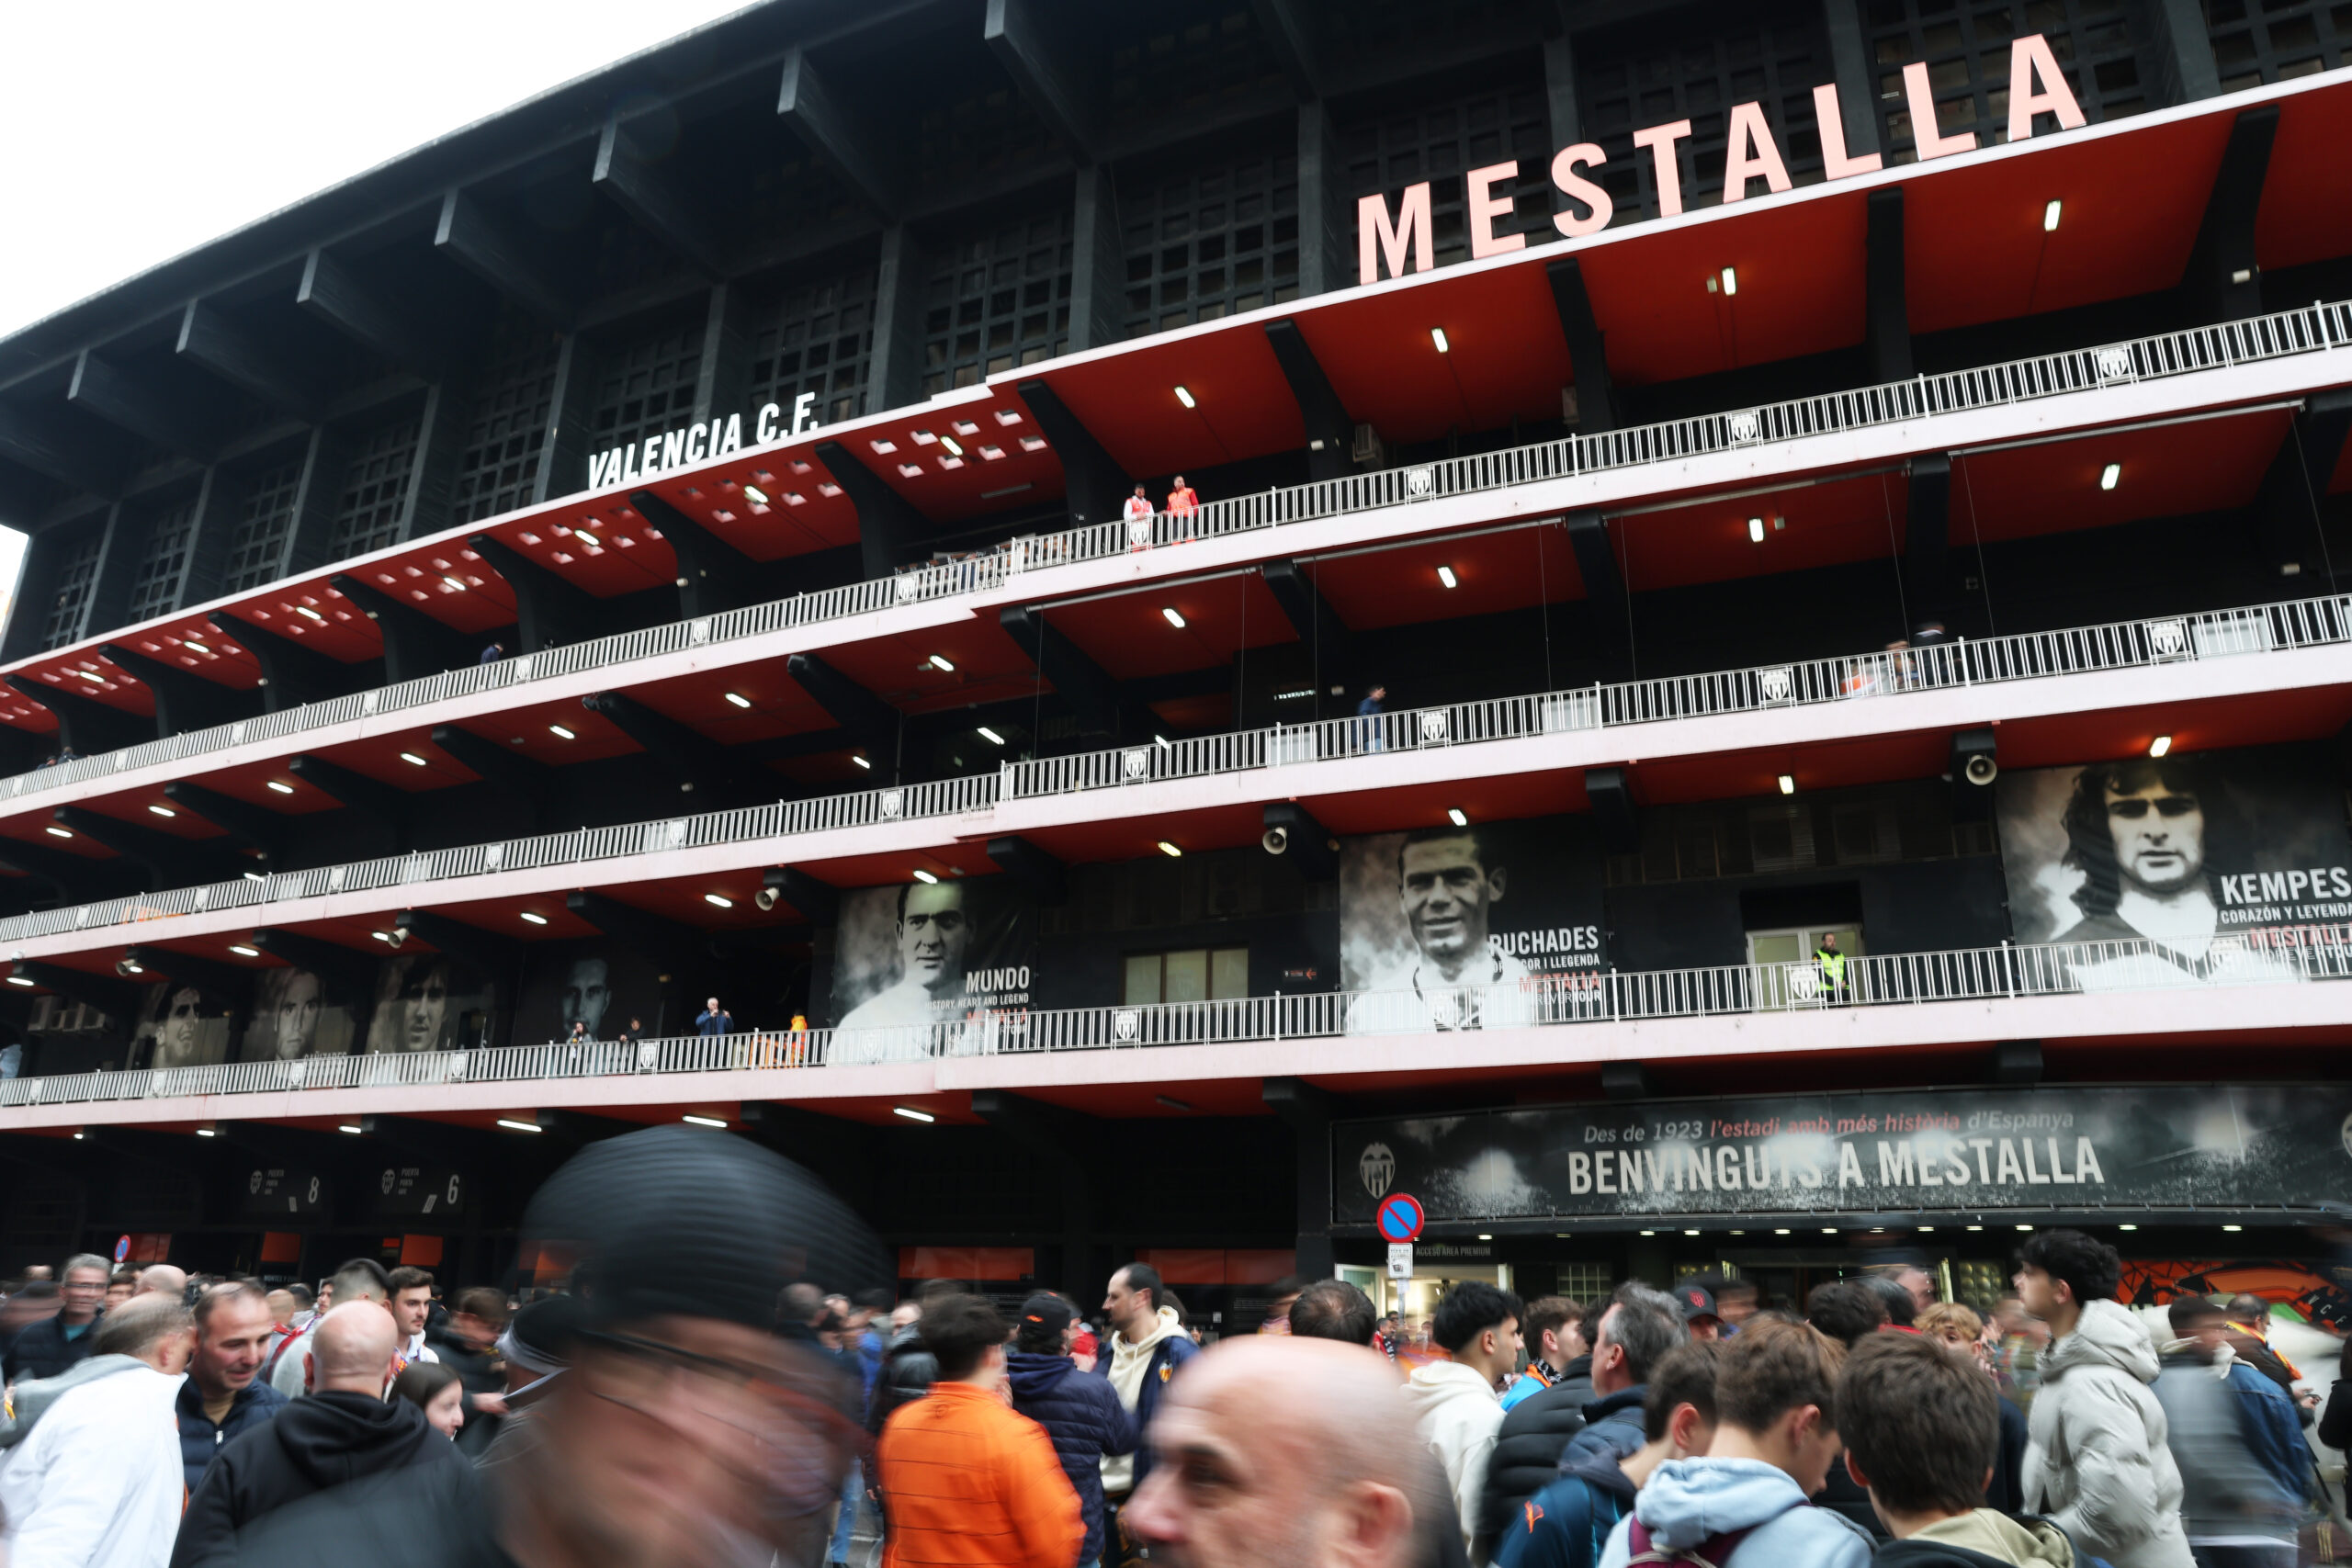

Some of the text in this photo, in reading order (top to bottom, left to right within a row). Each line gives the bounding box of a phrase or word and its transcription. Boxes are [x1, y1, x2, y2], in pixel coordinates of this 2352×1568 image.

[1358, 33, 2087, 286] MESTALLA
[588, 391, 819, 491] VALENCIA C.F.
[2221, 866, 2352, 905] KEMPES
[2221, 905, 2282, 925] CORAZÓN
[2283, 908, 2294, 920] Y
[1544, 956, 1548, 970] I
[1550, 953, 1600, 969] LLEGENDA
[966, 965, 1030, 994] MUNDO
[957, 997, 982, 1010] HEART
[983, 996, 998, 1007] AND
[1000, 992, 1029, 1006] LEGEND
[1584, 1110, 2075, 1145] Des de 1923 l'estadi amb més història d'Espanya
[1568, 1135, 2105, 1196] BENVINGUTS A MESTALLA
[308, 1176, 320, 1203] 8
[447, 1174, 459, 1204] 6
[1416, 1246, 1441, 1257] ACCESO
[1460, 1245, 1491, 1257] PREMIUM
